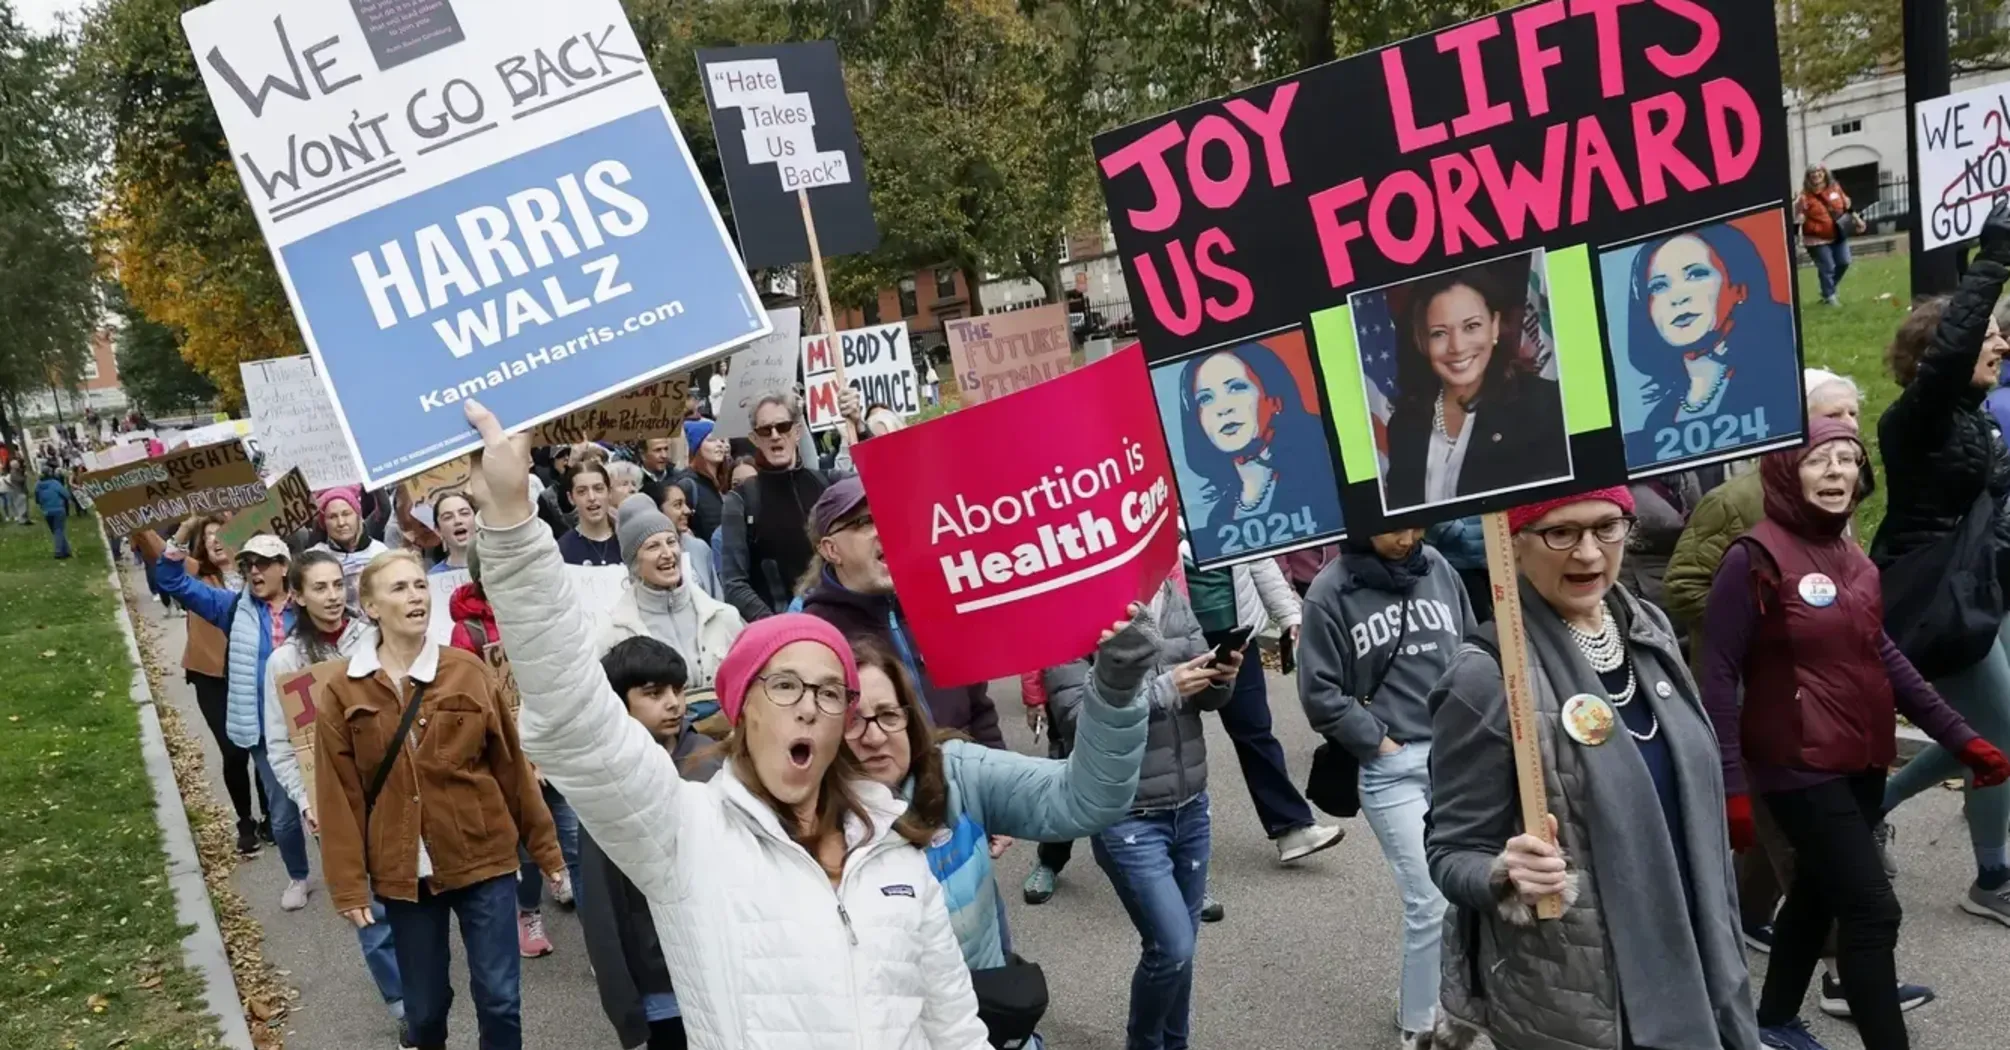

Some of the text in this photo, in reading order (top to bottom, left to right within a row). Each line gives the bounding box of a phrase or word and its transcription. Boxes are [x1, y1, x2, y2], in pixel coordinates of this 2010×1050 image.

[207, 14, 363, 118] WE
[241, 24, 645, 200] WON'T GO BACK
[747, 105, 808, 128] Takes
[1102, 0, 1720, 233] JOY LIFTS
[1922, 102, 1974, 152] WE
[766, 135, 796, 157] Us
[1133, 78, 1763, 337] US FORWARD
[1931, 196, 1972, 241] GO
[351, 158, 650, 330] HARRIS
[432, 253, 633, 360] WALZ
[950, 321, 993, 342] THE
[418, 297, 685, 414] KamalaHarris.com
[841, 327, 901, 368] BODY
[964, 325, 1069, 370] FUTURE
[662, 380, 686, 399] IS
[809, 381, 840, 424] M
[959, 371, 981, 391] IS
[1655, 406, 1770, 460] 2024
[165, 441, 248, 478] RIGHTS
[106, 496, 188, 537] HUMAN
[187, 481, 267, 512] RIGHTS
[146, 474, 196, 499] ARE
[931, 437, 1144, 545] Abortion is
[940, 510, 1117, 594] Health
[1217, 505, 1318, 555] 2024
[1350, 599, 1458, 660] BOSTON
